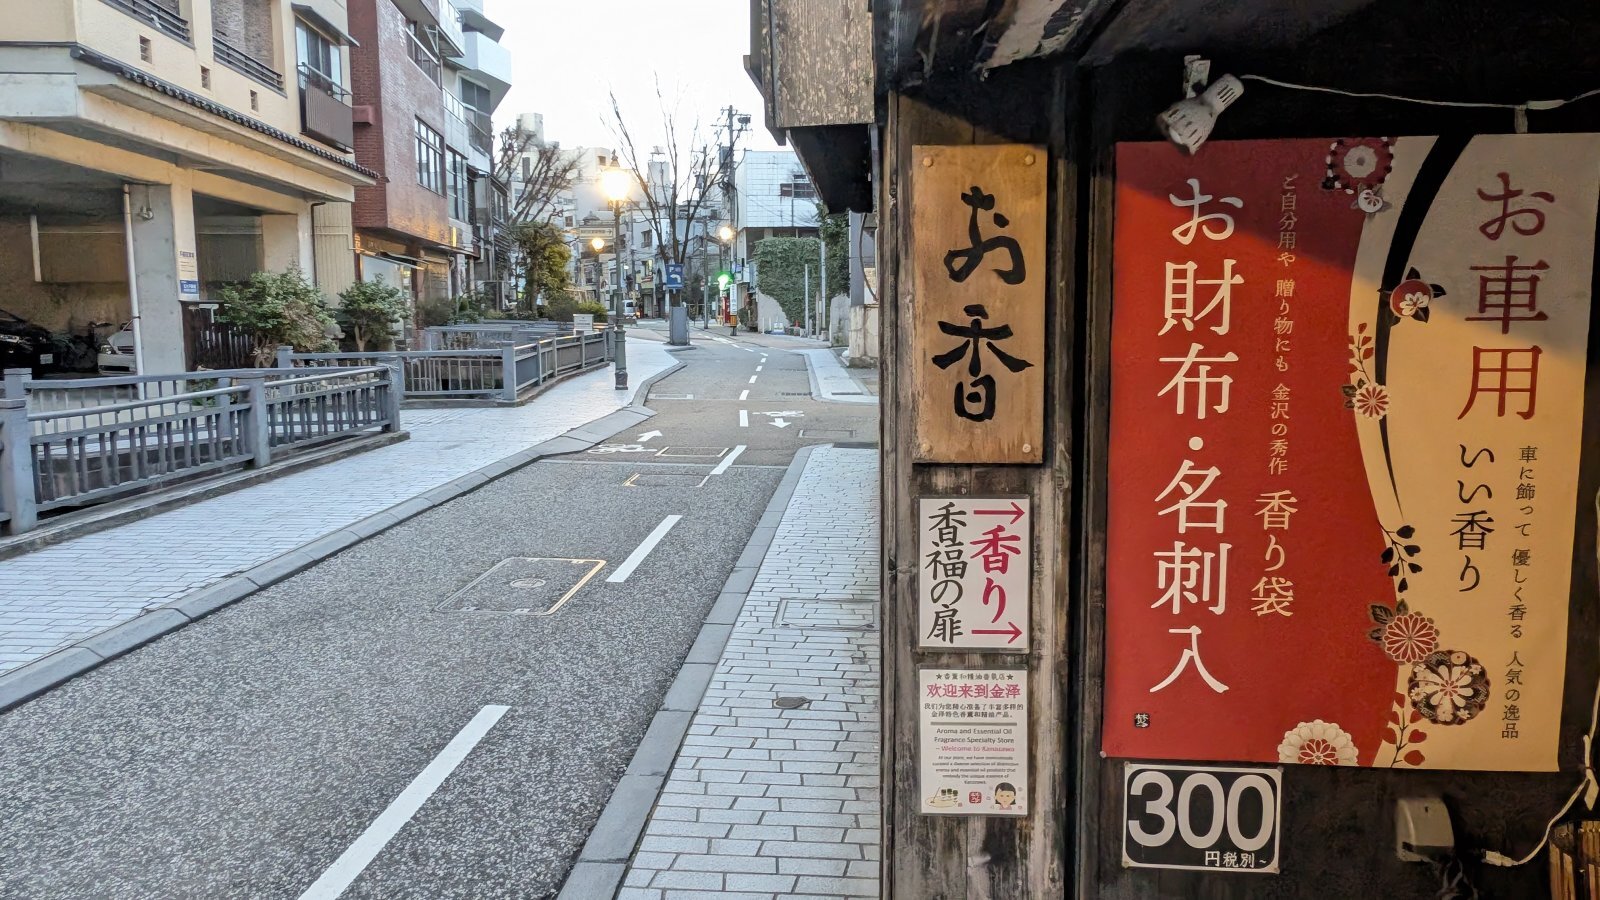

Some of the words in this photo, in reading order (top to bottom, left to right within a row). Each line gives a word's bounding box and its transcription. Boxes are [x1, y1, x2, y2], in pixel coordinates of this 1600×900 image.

[931, 185, 1035, 422] お香
[1273, 279, 1296, 372] 贈り物にも
[1457, 171, 1556, 421] お車用
[1150, 178, 1245, 694] お財布・名刺入
[1268, 382, 1291, 475] 金沢の秀作
[1449, 443, 1496, 592] いい香り
[1514, 446, 1538, 537] 車に飾って
[925, 502, 968, 644] 香福の扉
[970, 524, 1021, 624] 香り
[1250, 489, 1298, 618] 香り袋
[1508, 549, 1531, 639] 優しく香る
[926, 683, 1021, 698] 欢迎来到金泽
[1501, 651, 1524, 739] 人気の逸品
[934, 736, 966, 744] Fragrance
[1128, 770, 1275, 851] 300
